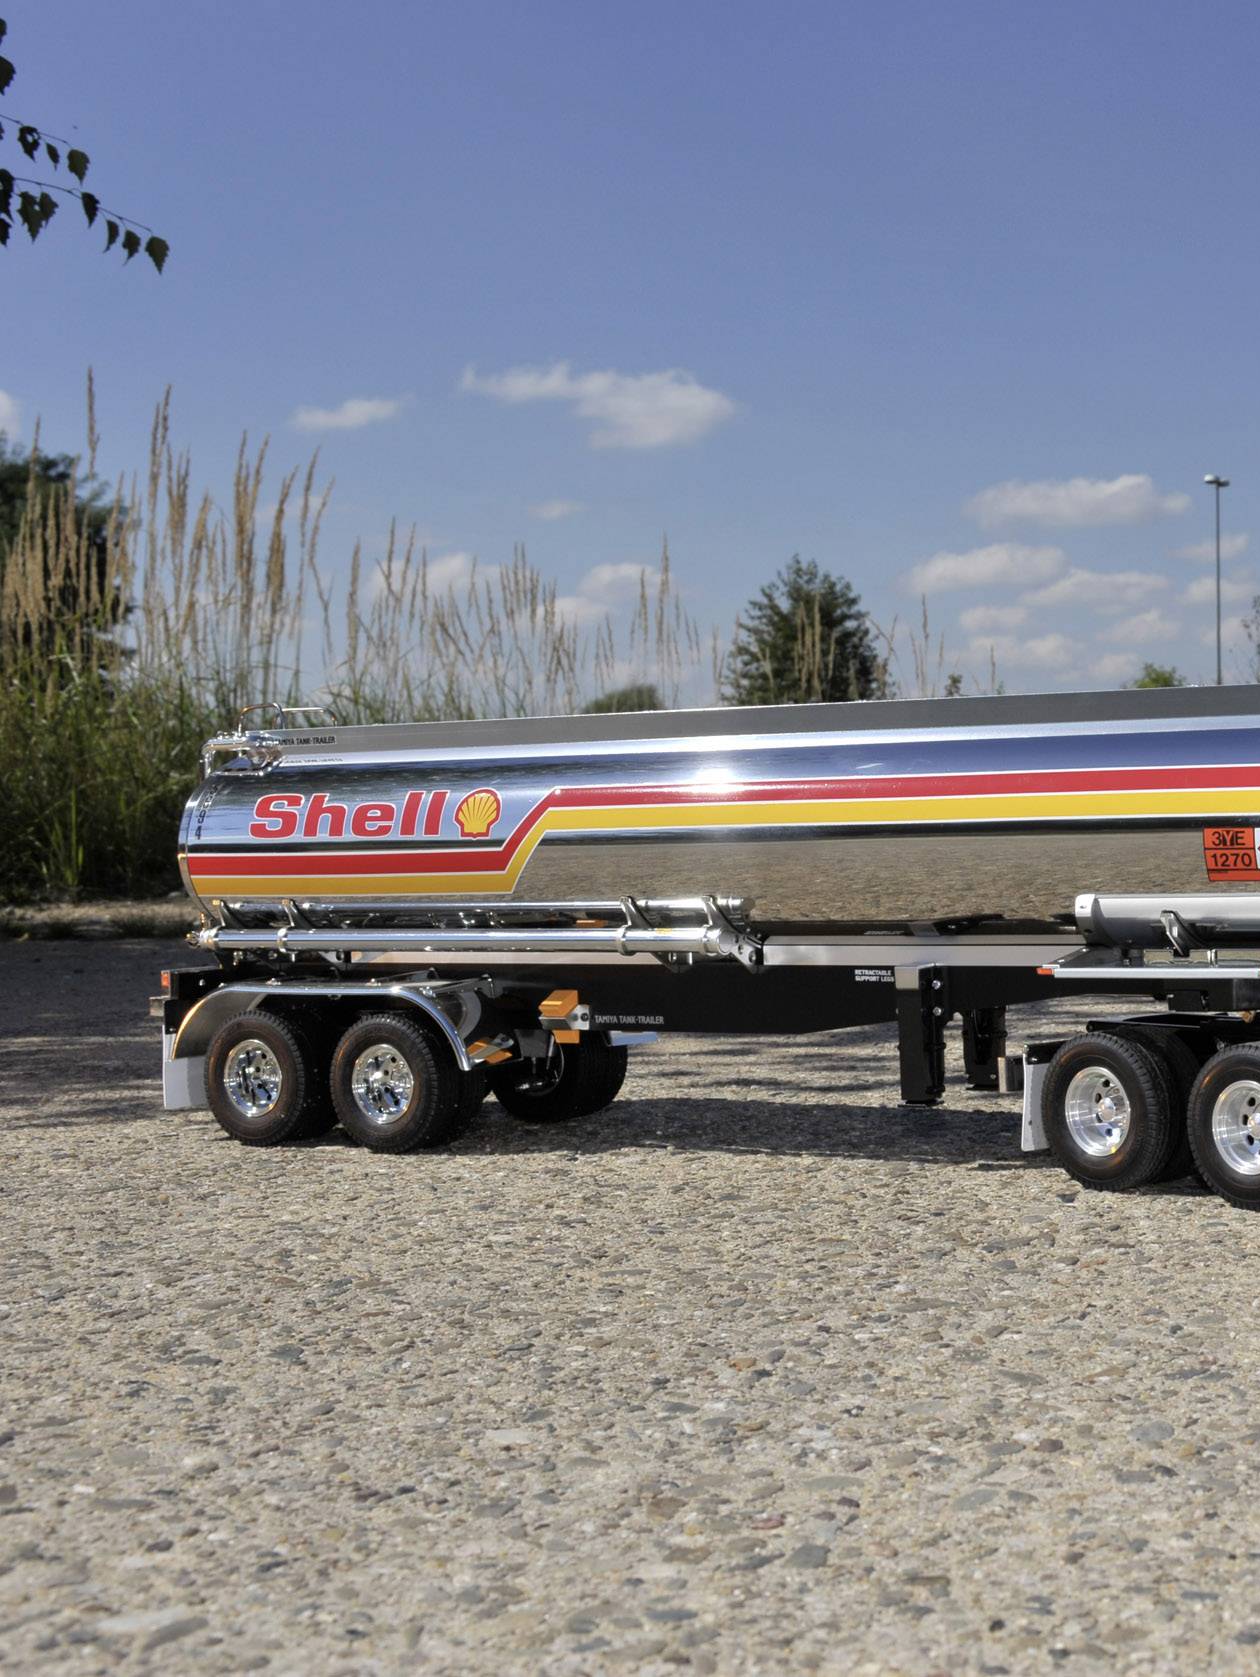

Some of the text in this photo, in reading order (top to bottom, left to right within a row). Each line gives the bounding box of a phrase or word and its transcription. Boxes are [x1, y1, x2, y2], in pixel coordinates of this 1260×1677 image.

[249, 790, 450, 840] Shell
[1211, 829, 1246, 847] 3YE
[1211, 852, 1253, 868] 1270
[594, 1015, 618, 1024] TAMIYA
